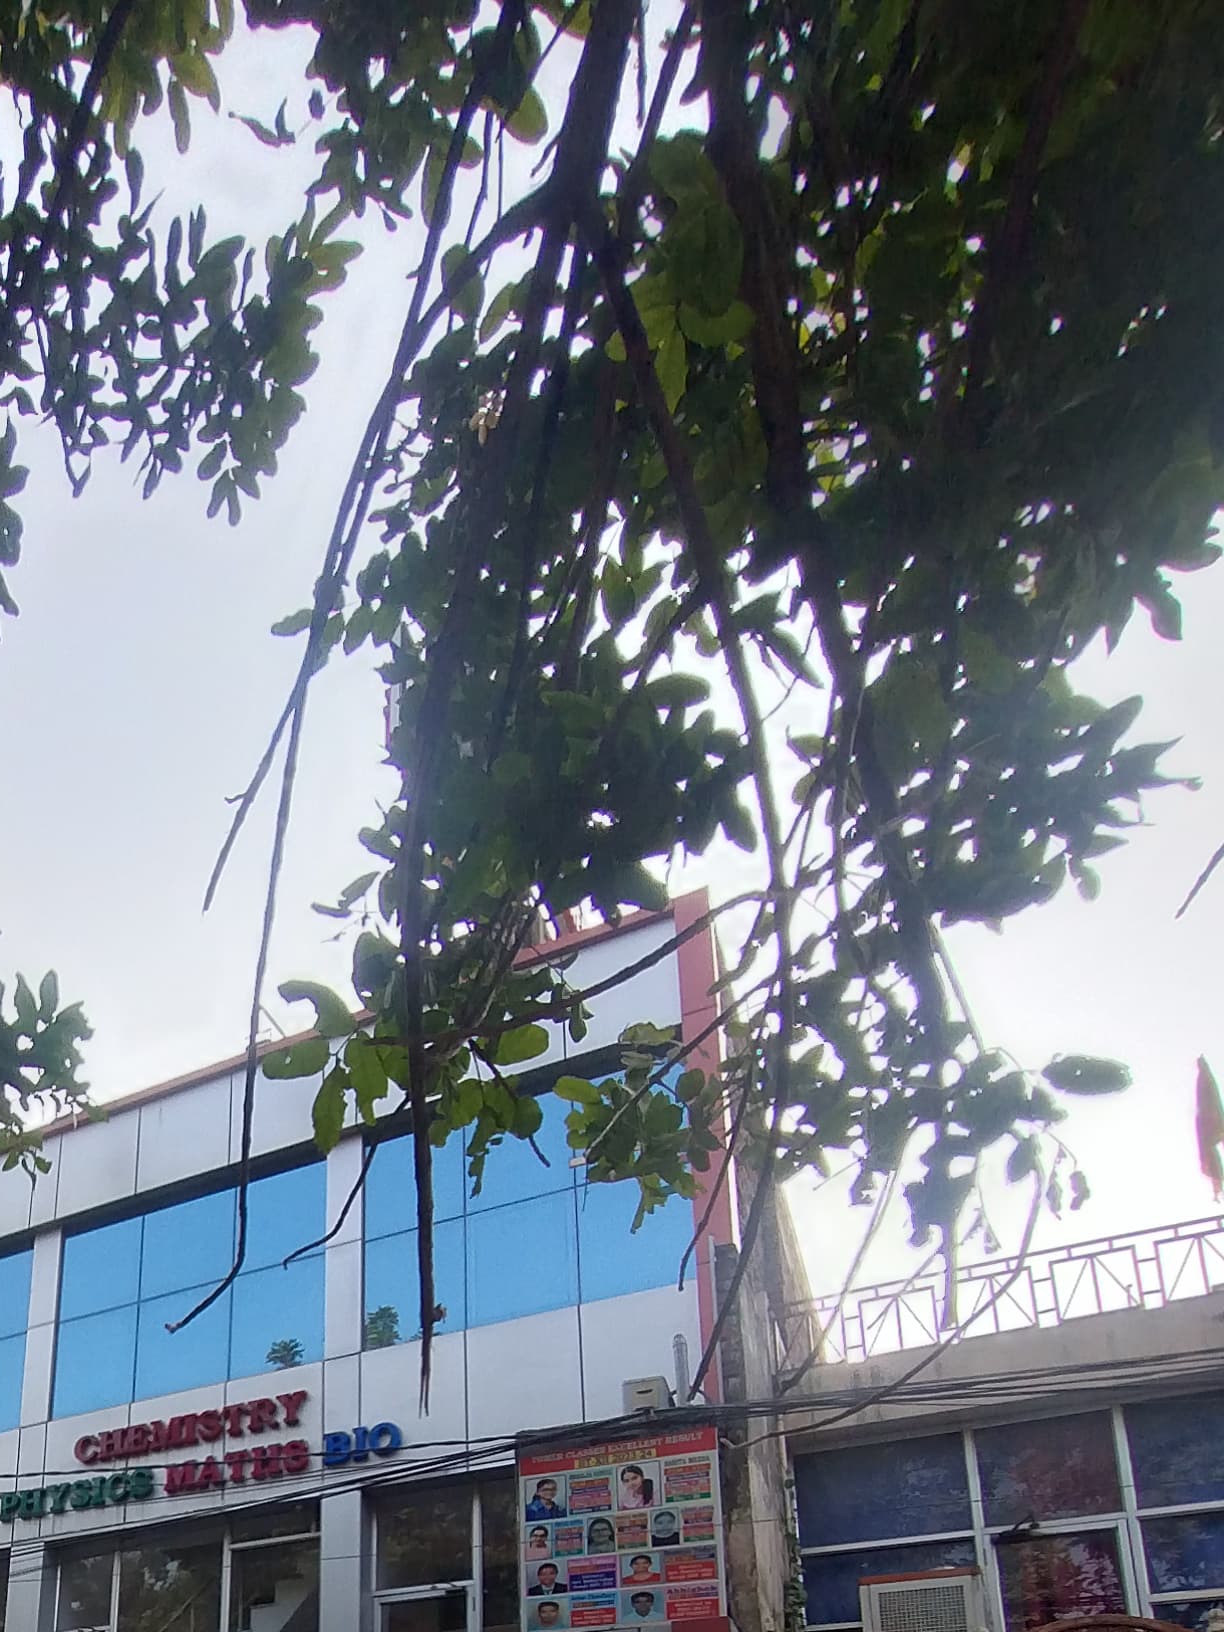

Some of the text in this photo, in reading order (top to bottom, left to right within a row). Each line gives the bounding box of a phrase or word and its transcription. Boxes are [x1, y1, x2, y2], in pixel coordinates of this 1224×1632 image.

[75, 1390, 308, 1464] CHEMISTRY
[164, 1440, 310, 1496] MATHS
[322, 1422, 403, 1467] BIO
